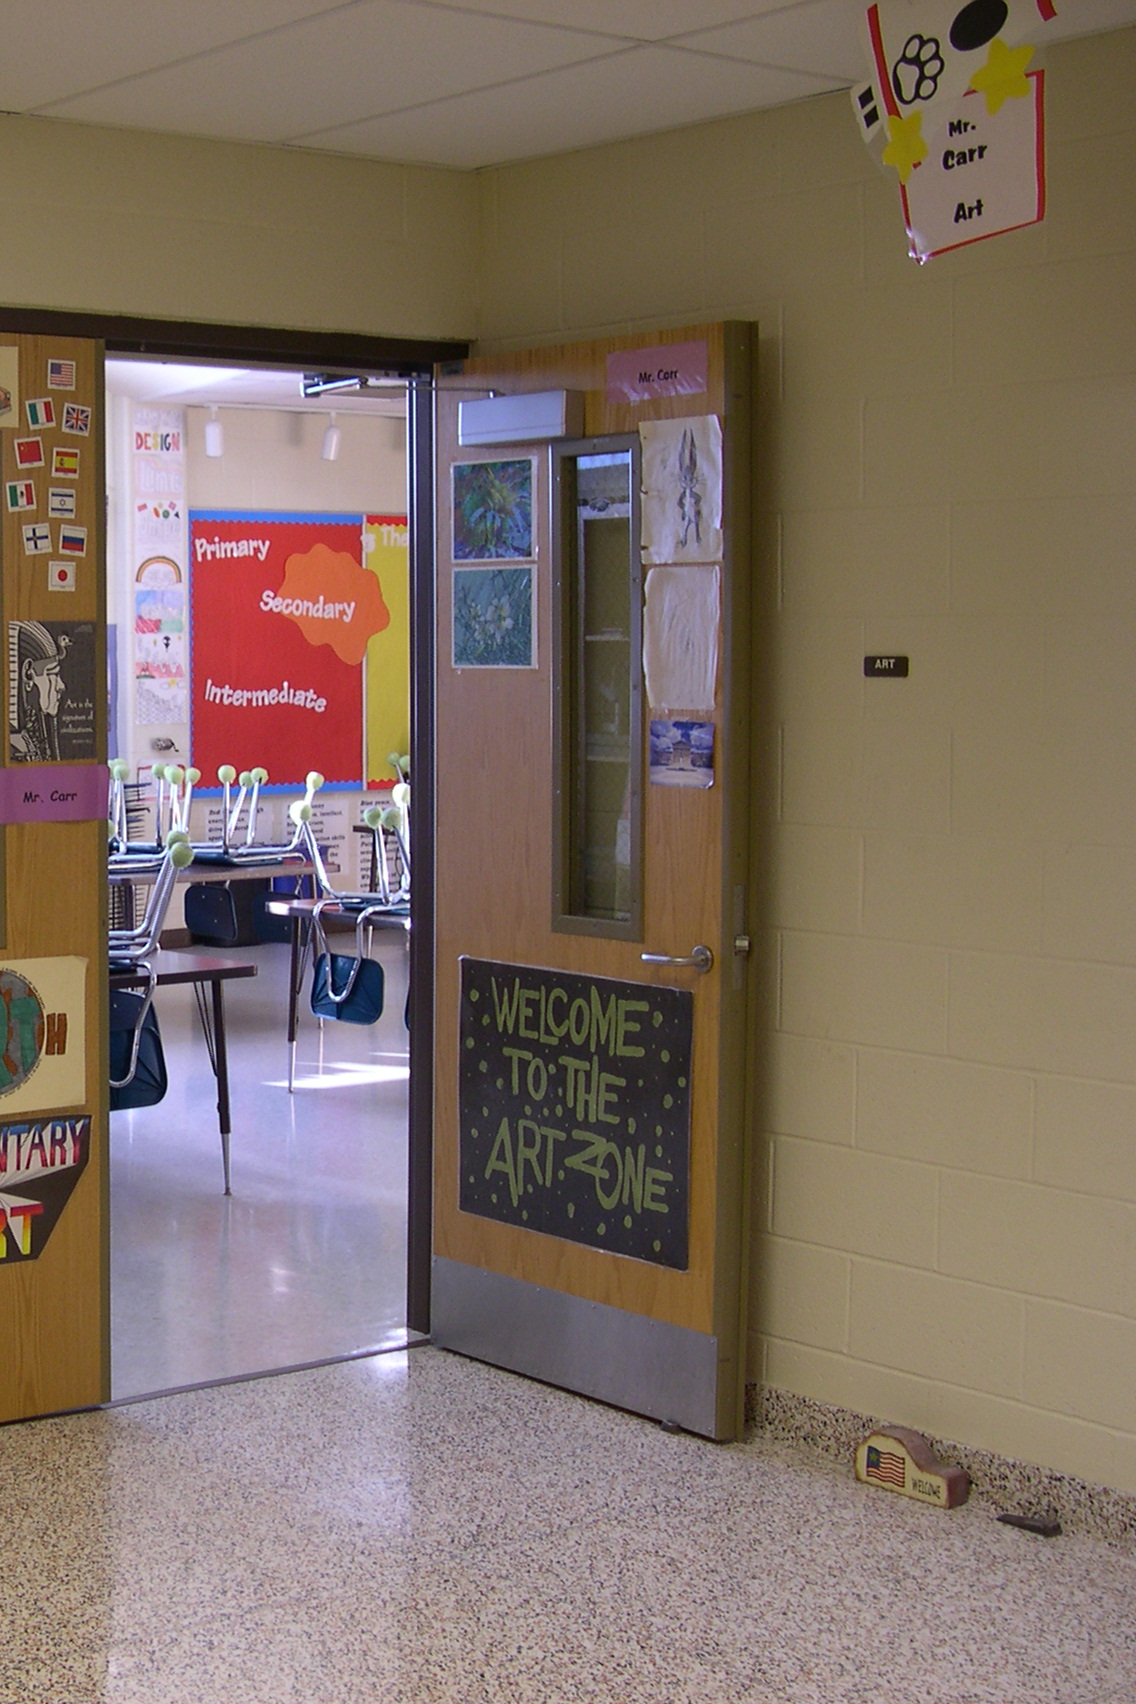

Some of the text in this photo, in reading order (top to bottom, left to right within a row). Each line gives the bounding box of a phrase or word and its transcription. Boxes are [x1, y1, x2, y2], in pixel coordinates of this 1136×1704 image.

[948, 119, 977, 138] Mr.
[942, 144, 987, 171] Carr
[953, 199, 984, 224] Art
[638, 371, 655, 384] Mr.
[135, 432, 180, 451] DESIGN
[195, 536, 270, 562] Primary
[259, 590, 355, 621] Secondary
[875, 658, 896, 669] ART
[205, 679, 327, 713] Intermediate
[23, 790, 78, 803] Mr. Carr
[491, 976, 649, 1057] WELCOME
[503, 1047, 626, 1124] TO THE
[485, 1117, 673, 1213] ART ZONE
[912, 1477, 941, 1500] WELCOME
